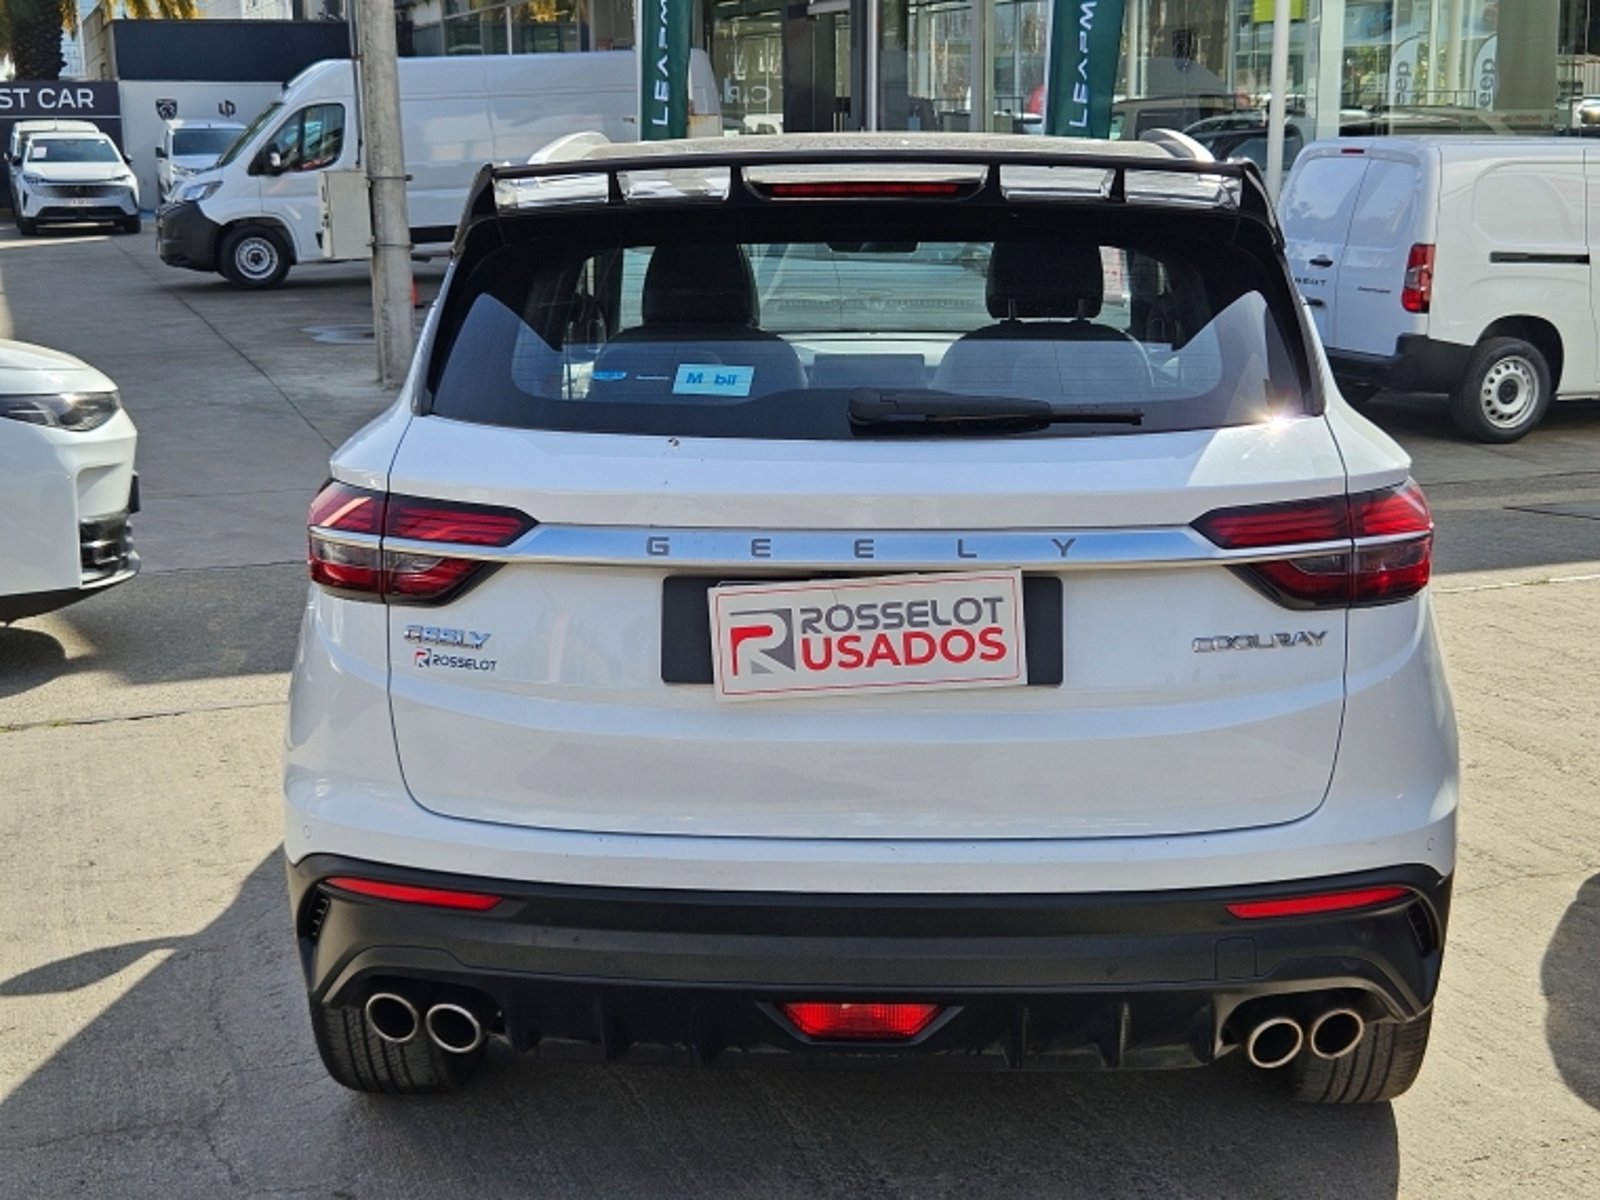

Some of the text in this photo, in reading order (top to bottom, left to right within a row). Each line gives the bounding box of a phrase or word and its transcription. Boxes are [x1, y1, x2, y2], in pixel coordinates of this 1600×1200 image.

[37, 88, 94, 109] CAR
[645, 536, 1077, 559] GEELY
[800, 596, 1005, 635] ROSSELOT
[801, 626, 1008, 671] USADOS
[1192, 629, 1329, 653] COOLRAY
[433, 654, 498, 671] ROSSELOT
